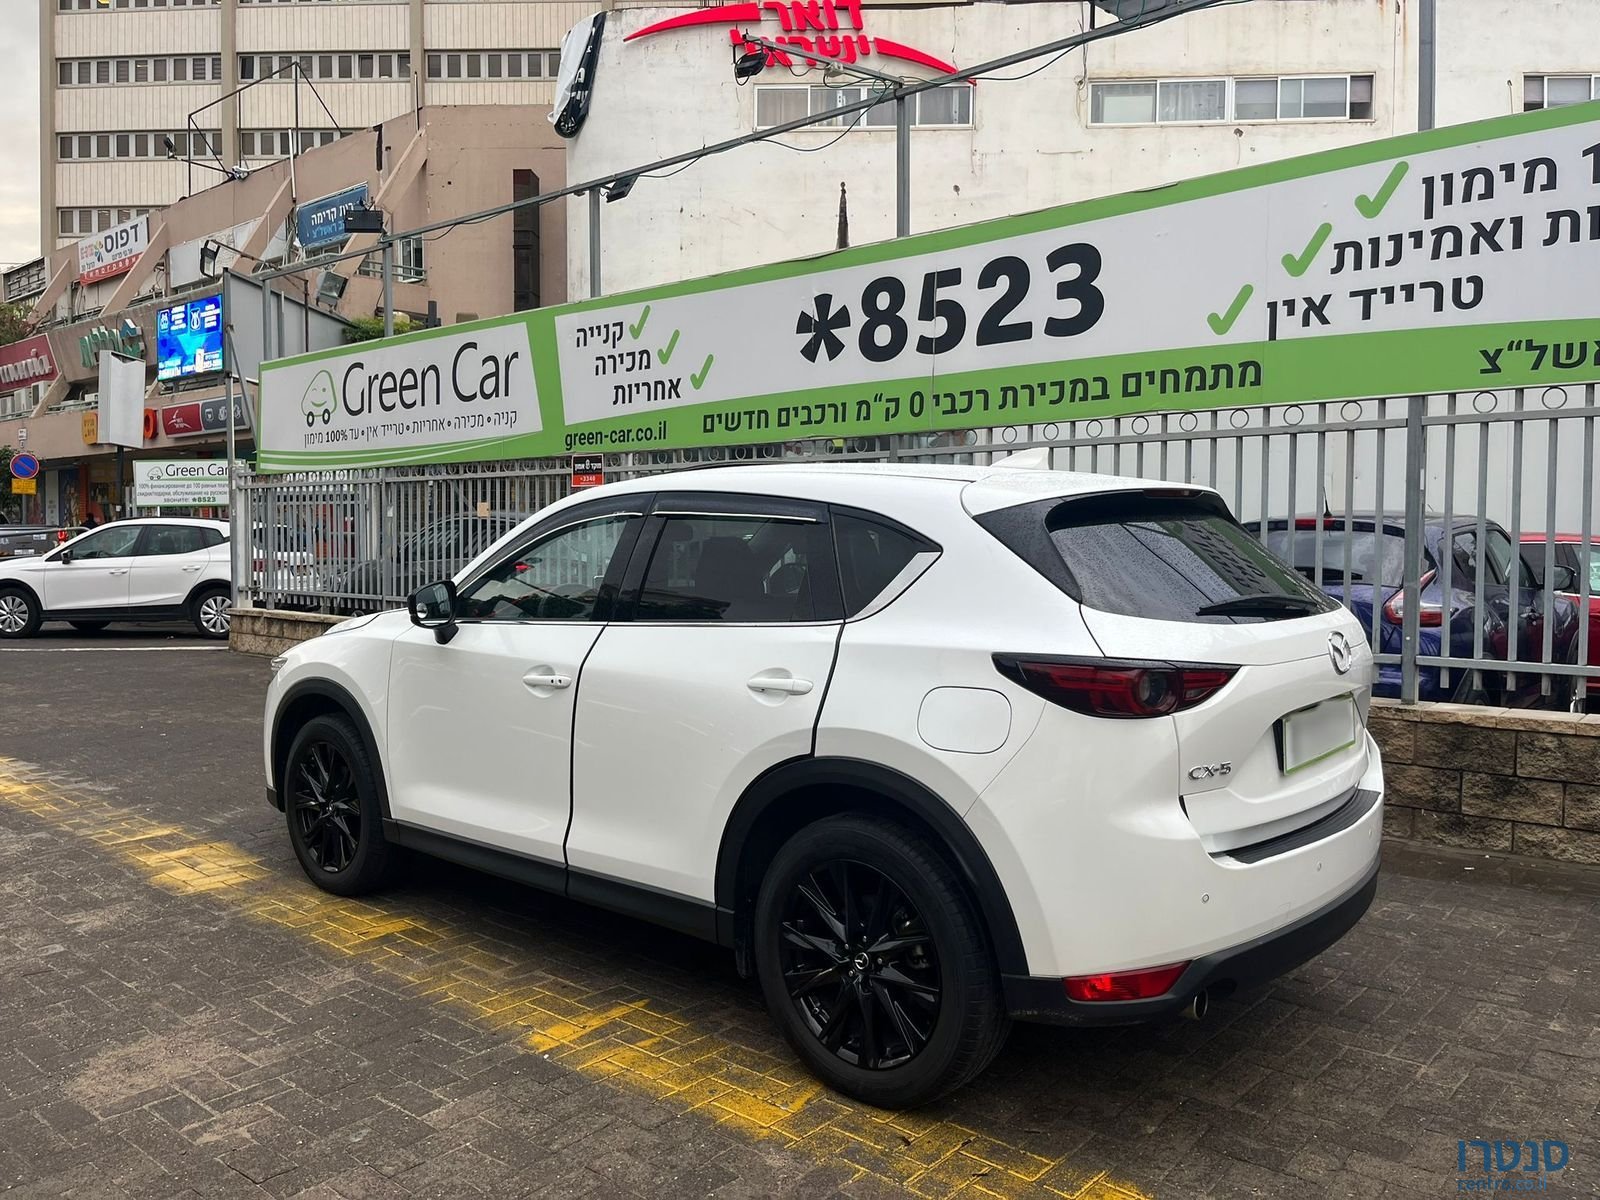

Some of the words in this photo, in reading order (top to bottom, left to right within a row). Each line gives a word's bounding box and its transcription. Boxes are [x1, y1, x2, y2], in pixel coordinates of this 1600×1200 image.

[763, 0, 863, 31] דואר
[1422, 157, 1557, 220] מימון
[311, 207, 337, 226] קדימה
[104, 223, 139, 254] דפוס
[1330, 216, 1523, 274] ואמינות
[1349, 275, 1483, 320] טרייד
[1266, 293, 1332, 341] אין
[576, 321, 624, 349] קנייה
[595, 349, 651, 376] מכירה
[343, 362, 441, 416] Green
[452, 342, 519, 403] Car
[612, 377, 682, 405] אחריות
[1122, 360, 1262, 397] מתמחים
[909, 391, 924, 417] 0
[932, 389, 989, 415] רכבי
[998, 376, 1110, 410] במכירת
[412, 418, 446, 434] אחריות
[454, 414, 484, 430] מכירה
[493, 411, 517, 429] קניה
[703, 409, 769, 433] חדשים
[777, 402, 847, 427] ורכבים
[304, 431, 324, 448] מימון
[326, 430, 348, 443] 100%
[349, 428, 360, 440] עד
[366, 425, 378, 442] אין
[381, 423, 404, 436] טרייד
[565, 420, 667, 451] green-car.co.il
[165, 464, 204, 477] Green
[1188, 761, 1232, 781] CX-5
